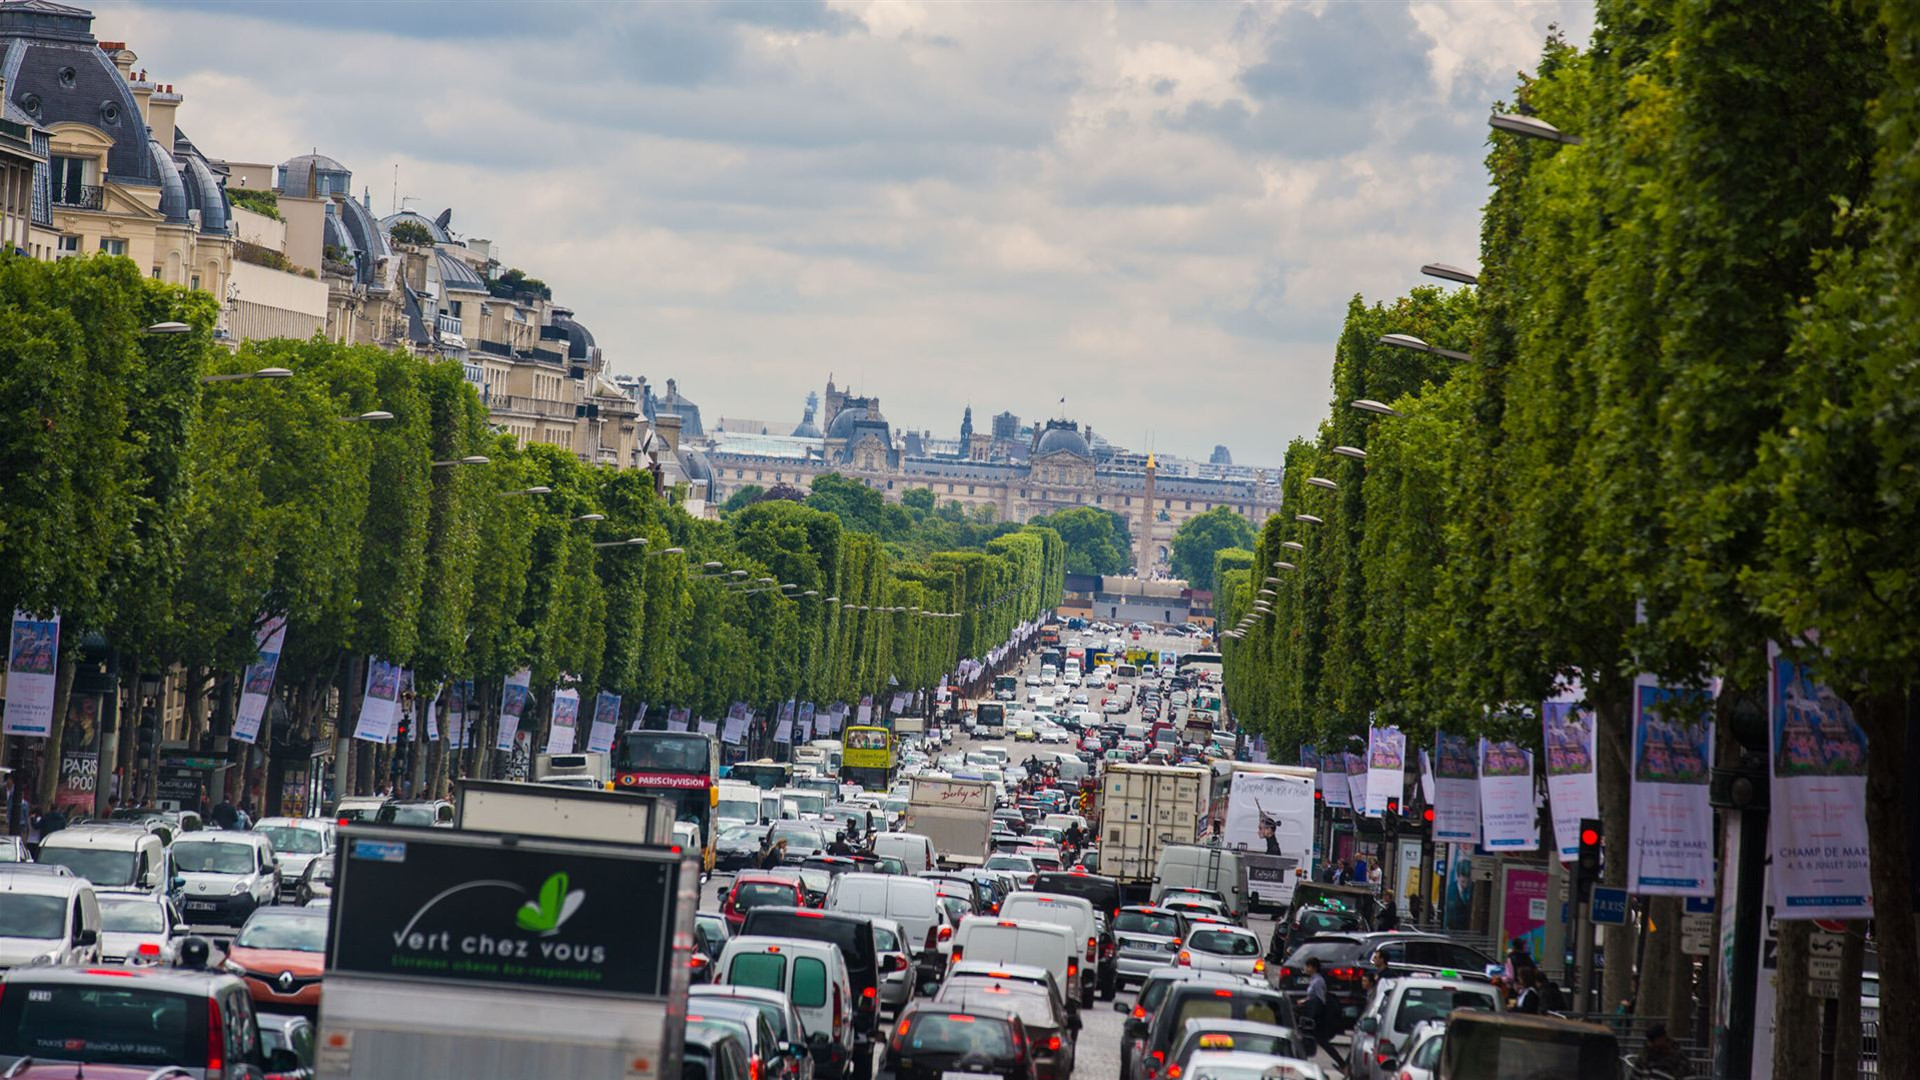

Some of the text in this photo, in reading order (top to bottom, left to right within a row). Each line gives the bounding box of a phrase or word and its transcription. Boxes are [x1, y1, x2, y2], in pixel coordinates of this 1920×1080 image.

[62, 757, 98, 775] PARIS
[68, 775, 94, 791] 1900
[638, 776, 705, 787] PARISCityVISION
[1779, 846, 1868, 859] CHAMP DE MAR
[1815, 861, 1844, 871] JUILLET
[1593, 898, 1626, 913] TAXIS
[461, 934, 529, 958] chez
[540, 942, 605, 964] vous
[391, 954, 449, 971] Livraison
[452, 959, 498, 973] urbaine
[36, 1039, 63, 1048] TAXIS
